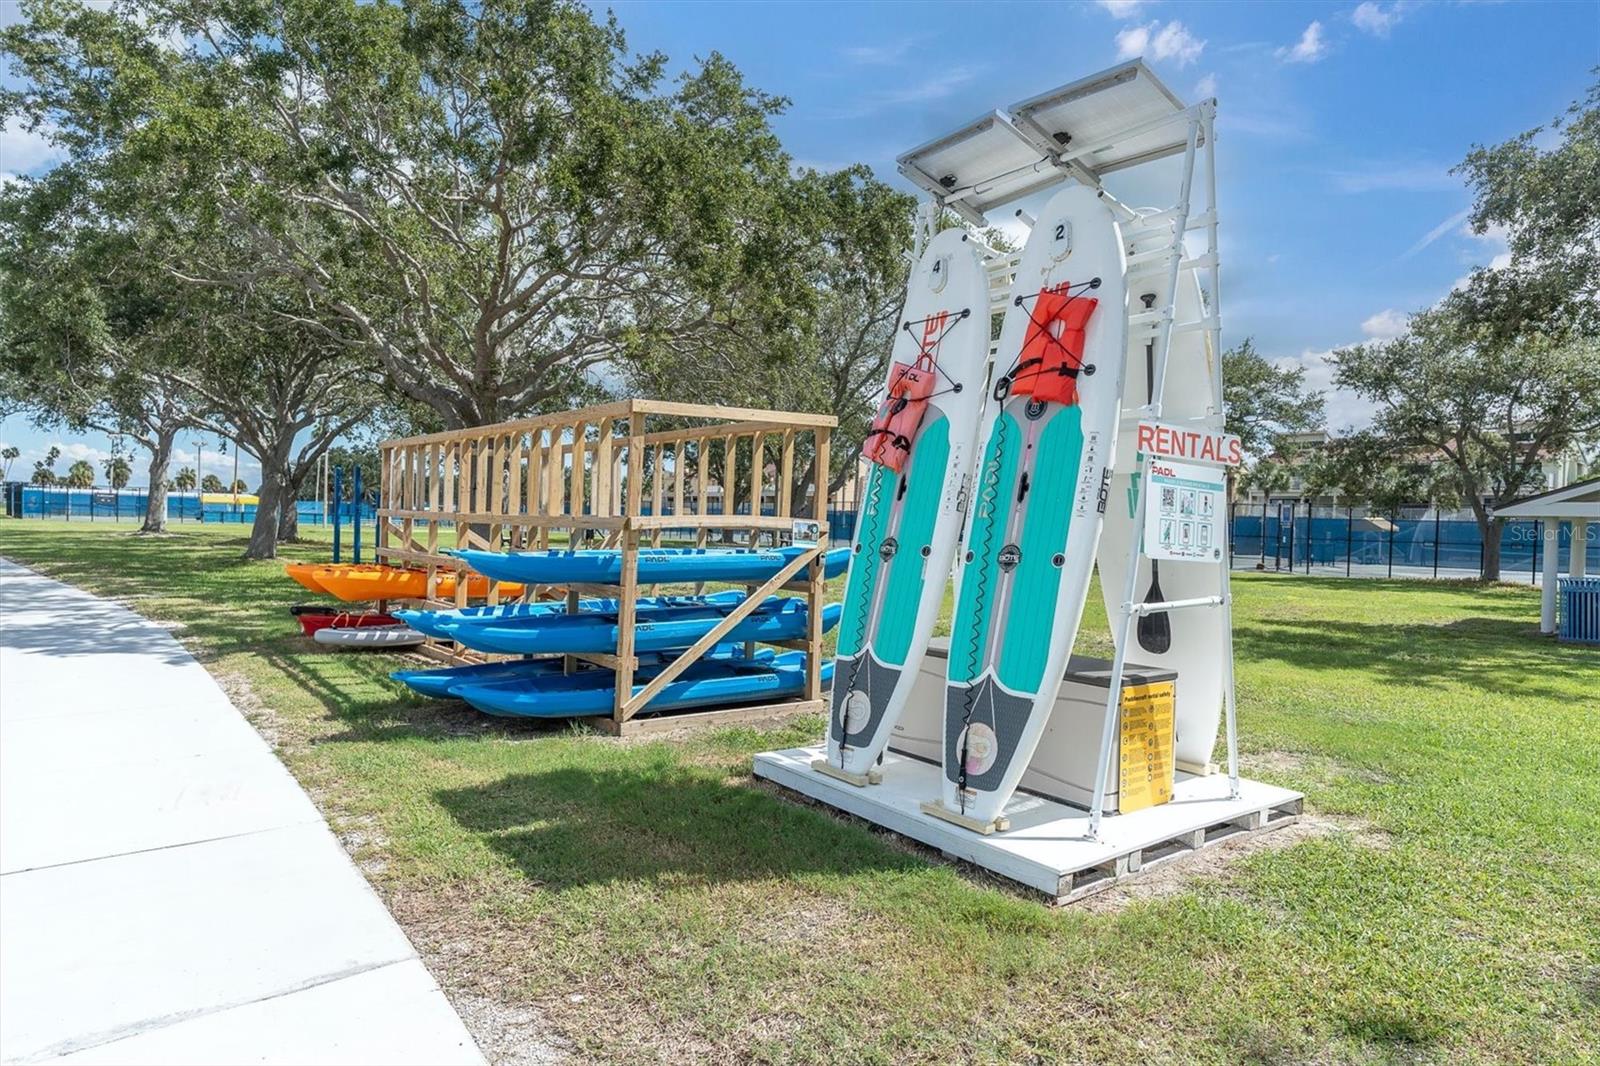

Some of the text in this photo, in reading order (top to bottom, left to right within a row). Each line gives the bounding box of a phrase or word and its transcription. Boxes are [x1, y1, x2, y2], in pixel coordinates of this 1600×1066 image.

[1055, 224, 1065, 241] 2
[932, 259, 941, 274] 4
[1138, 425, 1241, 464] RENTALS
[1152, 466, 1176, 477] PADL
[1096, 466, 1114, 514] BOTE
[634, 624, 655, 632] ADL
